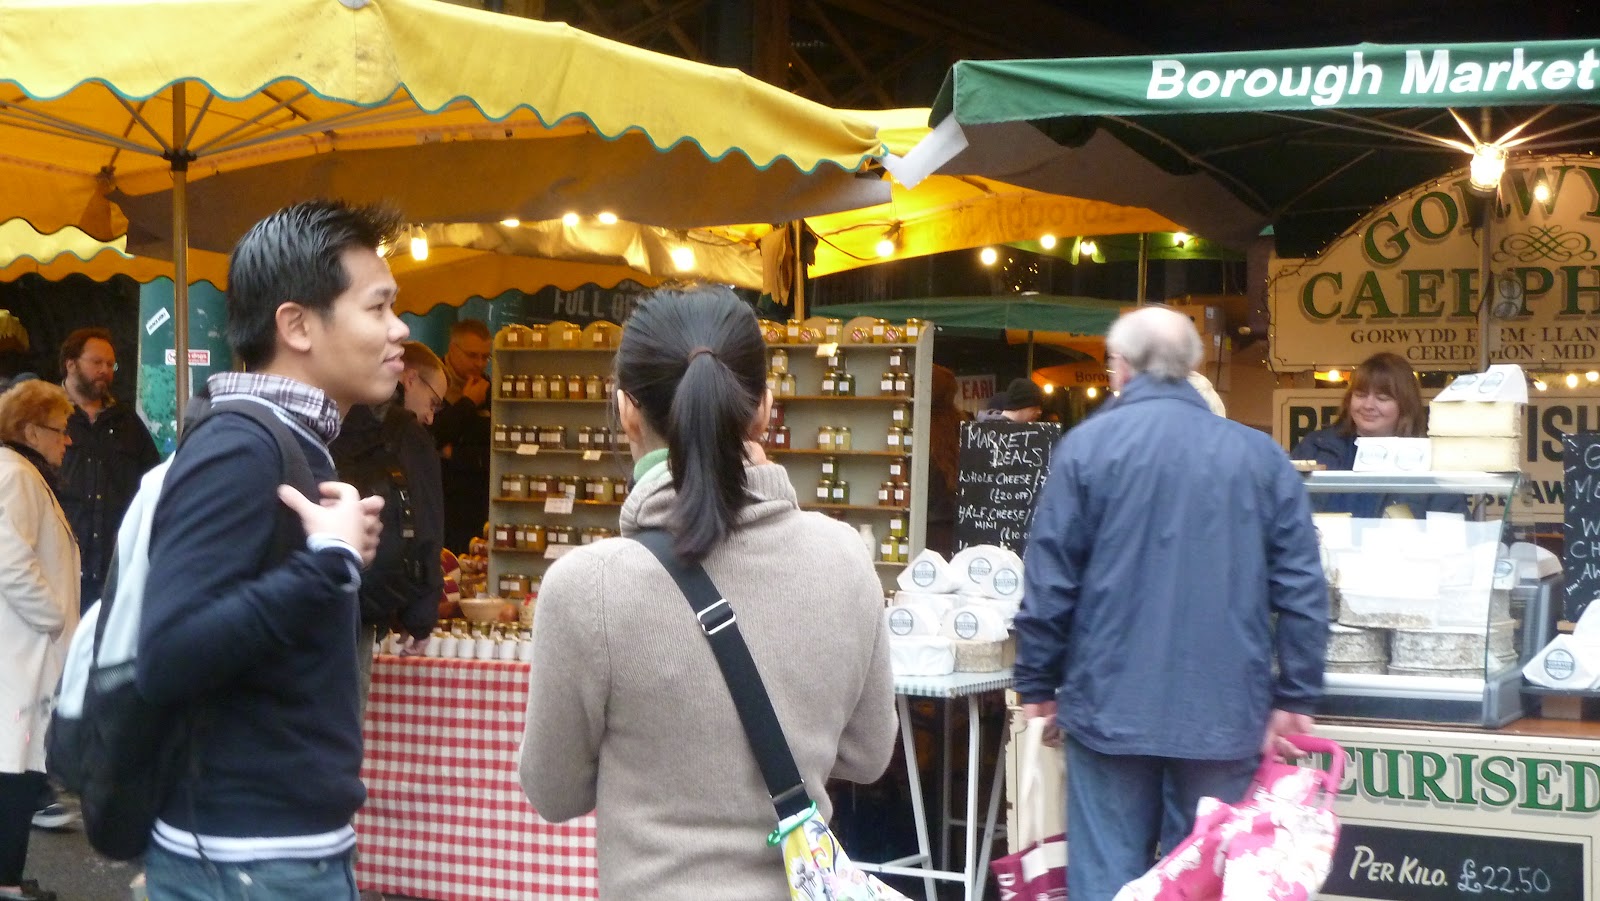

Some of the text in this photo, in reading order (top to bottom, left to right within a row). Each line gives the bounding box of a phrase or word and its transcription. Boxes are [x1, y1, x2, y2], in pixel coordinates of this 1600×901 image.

[1146, 48, 1599, 106] Borough Market
[553, 287, 605, 318] FULL
[1350, 327, 1457, 344] GORWYDD
[1466, 327, 1525, 343] FRM
[1552, 344, 1595, 360] MID
[968, 424, 1039, 449] MARKET
[989, 447, 1042, 468] DEALS
[959, 470, 993, 484] WHOLE
[975, 520, 997, 530] MINI
[1457, 859, 1550, 894] £22.50
